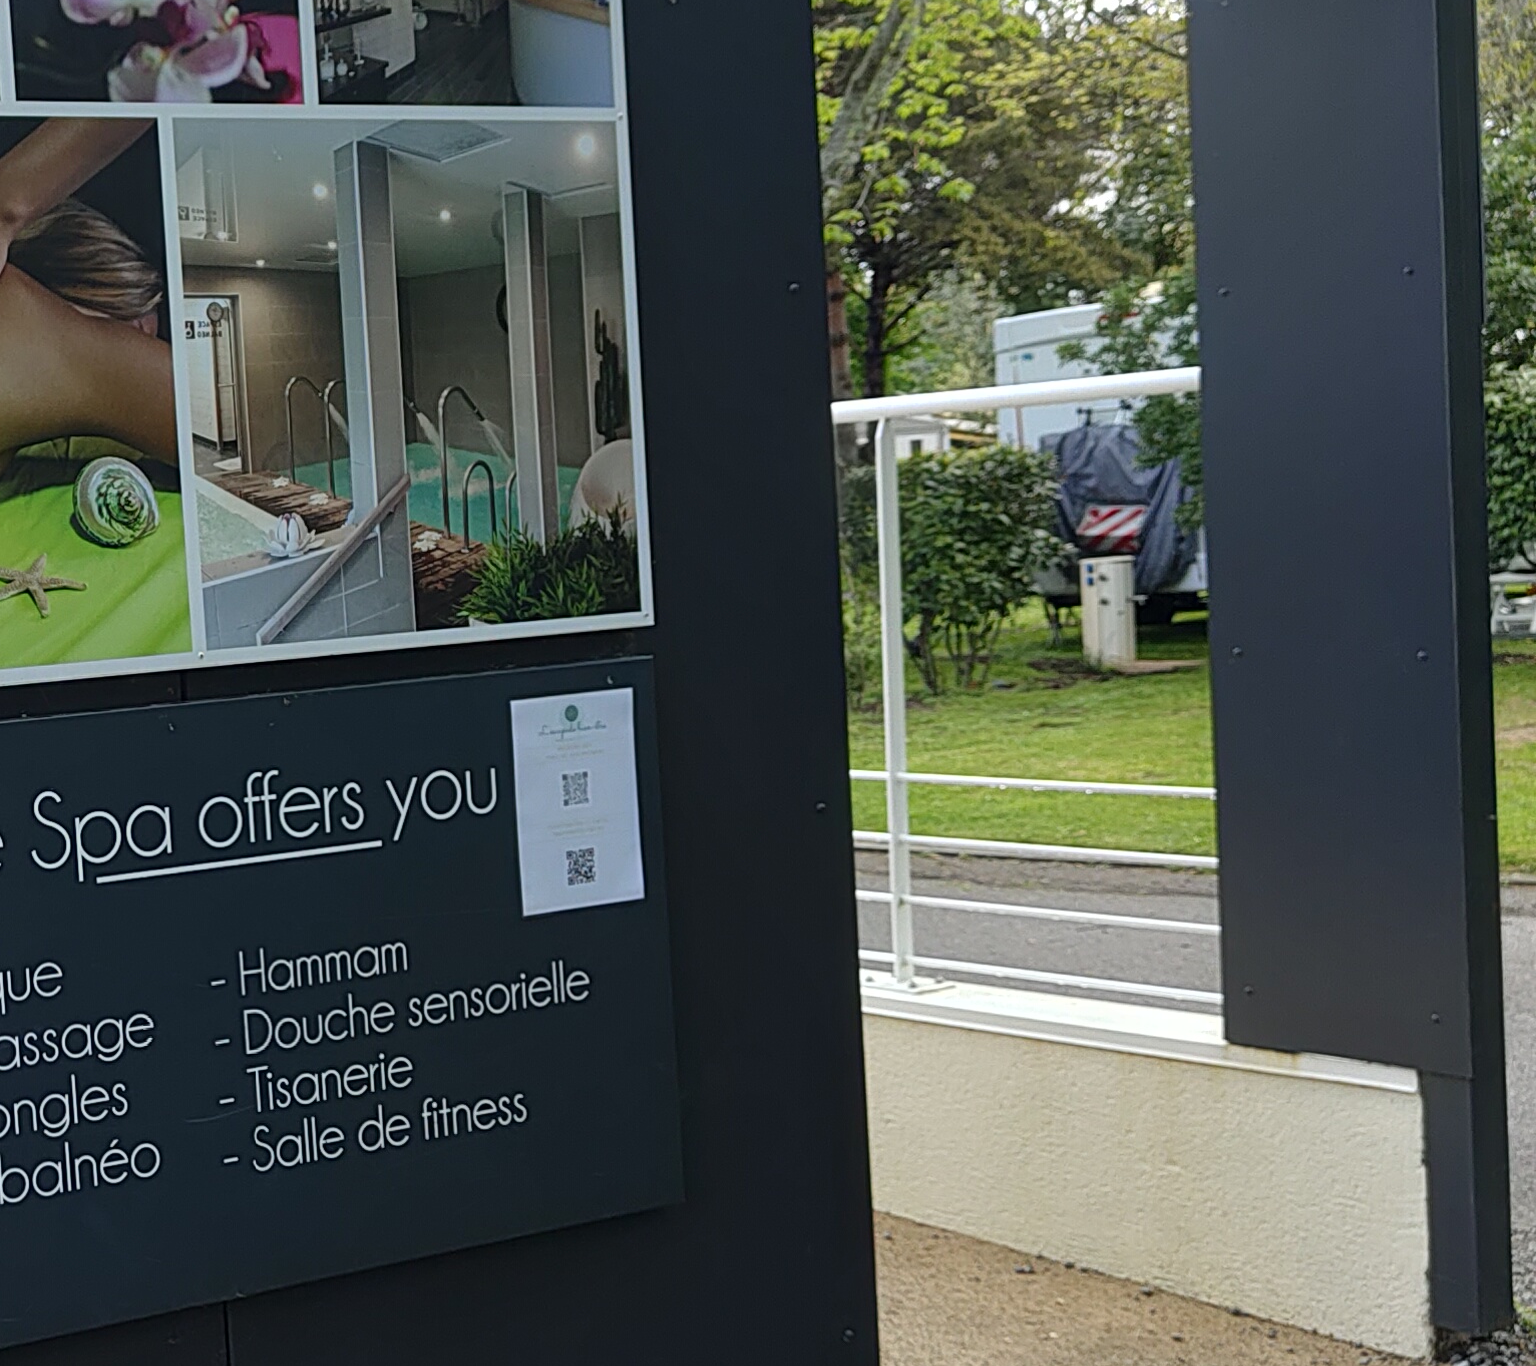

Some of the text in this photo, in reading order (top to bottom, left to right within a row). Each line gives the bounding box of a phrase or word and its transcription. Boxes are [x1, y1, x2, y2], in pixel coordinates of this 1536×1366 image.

[31, 790, 173, 882] Spa
[198, 769, 365, 848] offers
[385, 767, 497, 841] you
[238, 942, 408, 996] Hammam
[243, 993, 396, 1055] Douche
[408, 959, 590, 1027] sensorielle
[246, 1052, 413, 1113] Tisanerie
[252, 1116, 345, 1172] Salle
[357, 1104, 411, 1152] de
[421, 1093, 528, 1141] fitness
